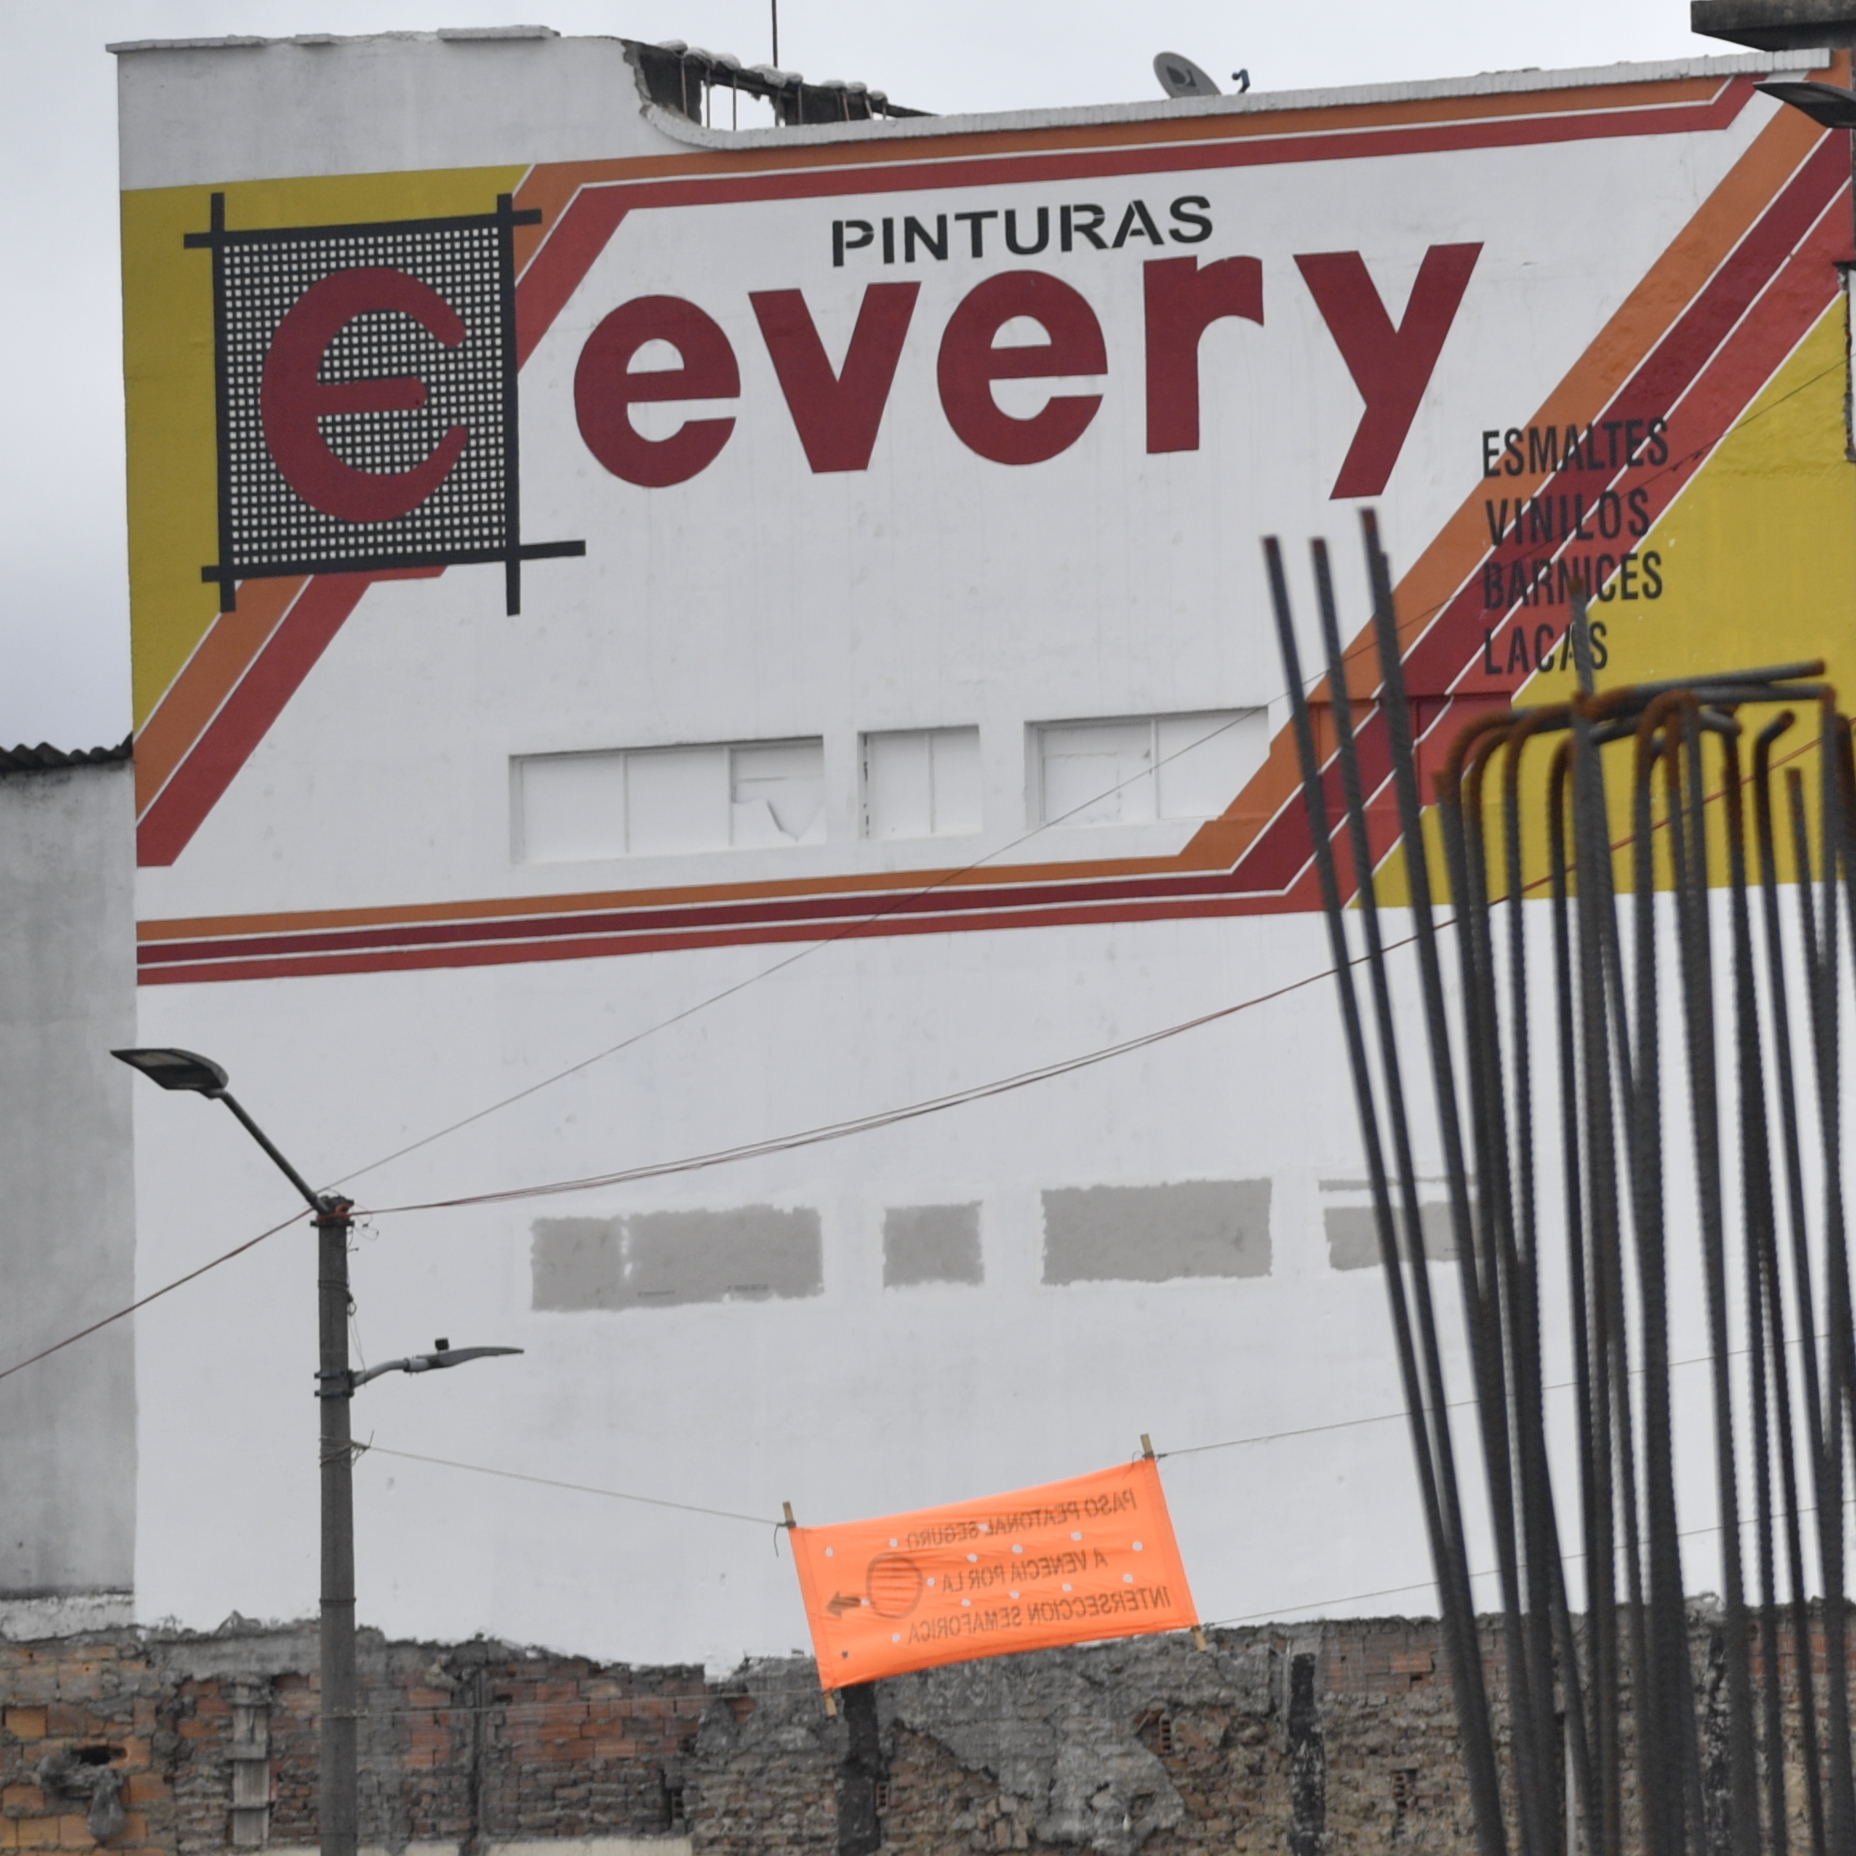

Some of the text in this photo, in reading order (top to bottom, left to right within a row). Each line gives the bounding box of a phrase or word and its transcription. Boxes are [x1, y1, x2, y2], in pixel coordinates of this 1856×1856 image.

[832, 195, 1214, 267] PINTURAS
[574, 242, 1484, 500] every
[1482, 416, 1670, 479] ESMALTES
[1486, 488, 1650, 547] VINILOS
[1483, 551, 1663, 611] BARNICES
[1483, 622, 1609, 677] LACAS
